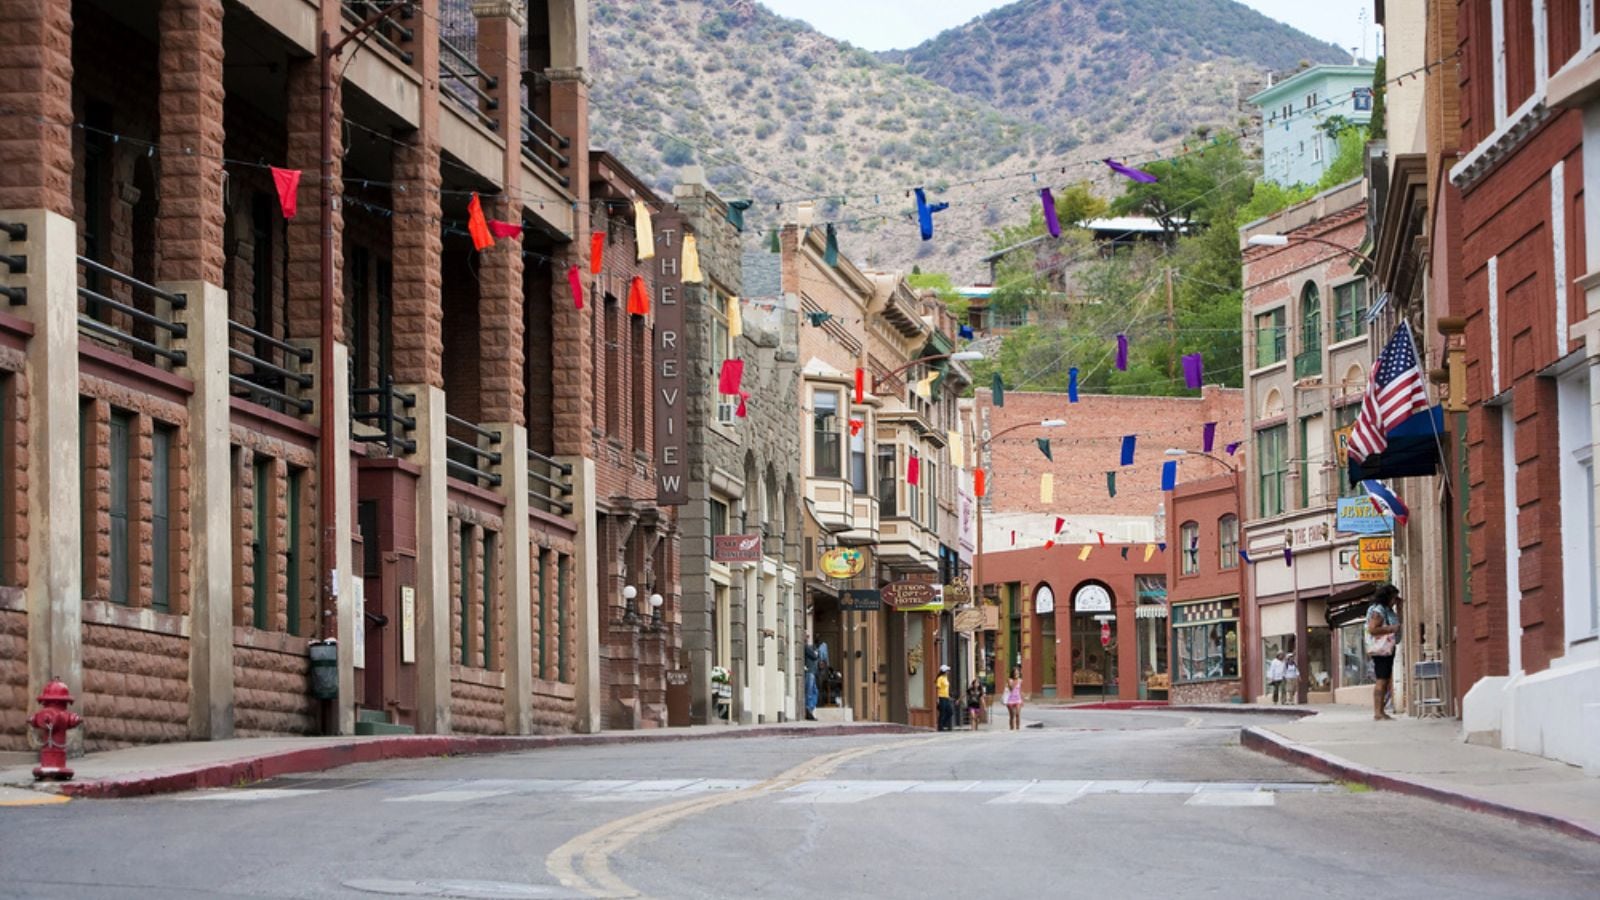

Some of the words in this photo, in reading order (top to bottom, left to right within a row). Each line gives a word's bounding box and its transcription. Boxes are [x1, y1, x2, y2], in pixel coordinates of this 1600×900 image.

[661, 228, 678, 305] THE
[661, 331, 681, 493] REVIEW
[895, 597, 922, 605] HOTEL
